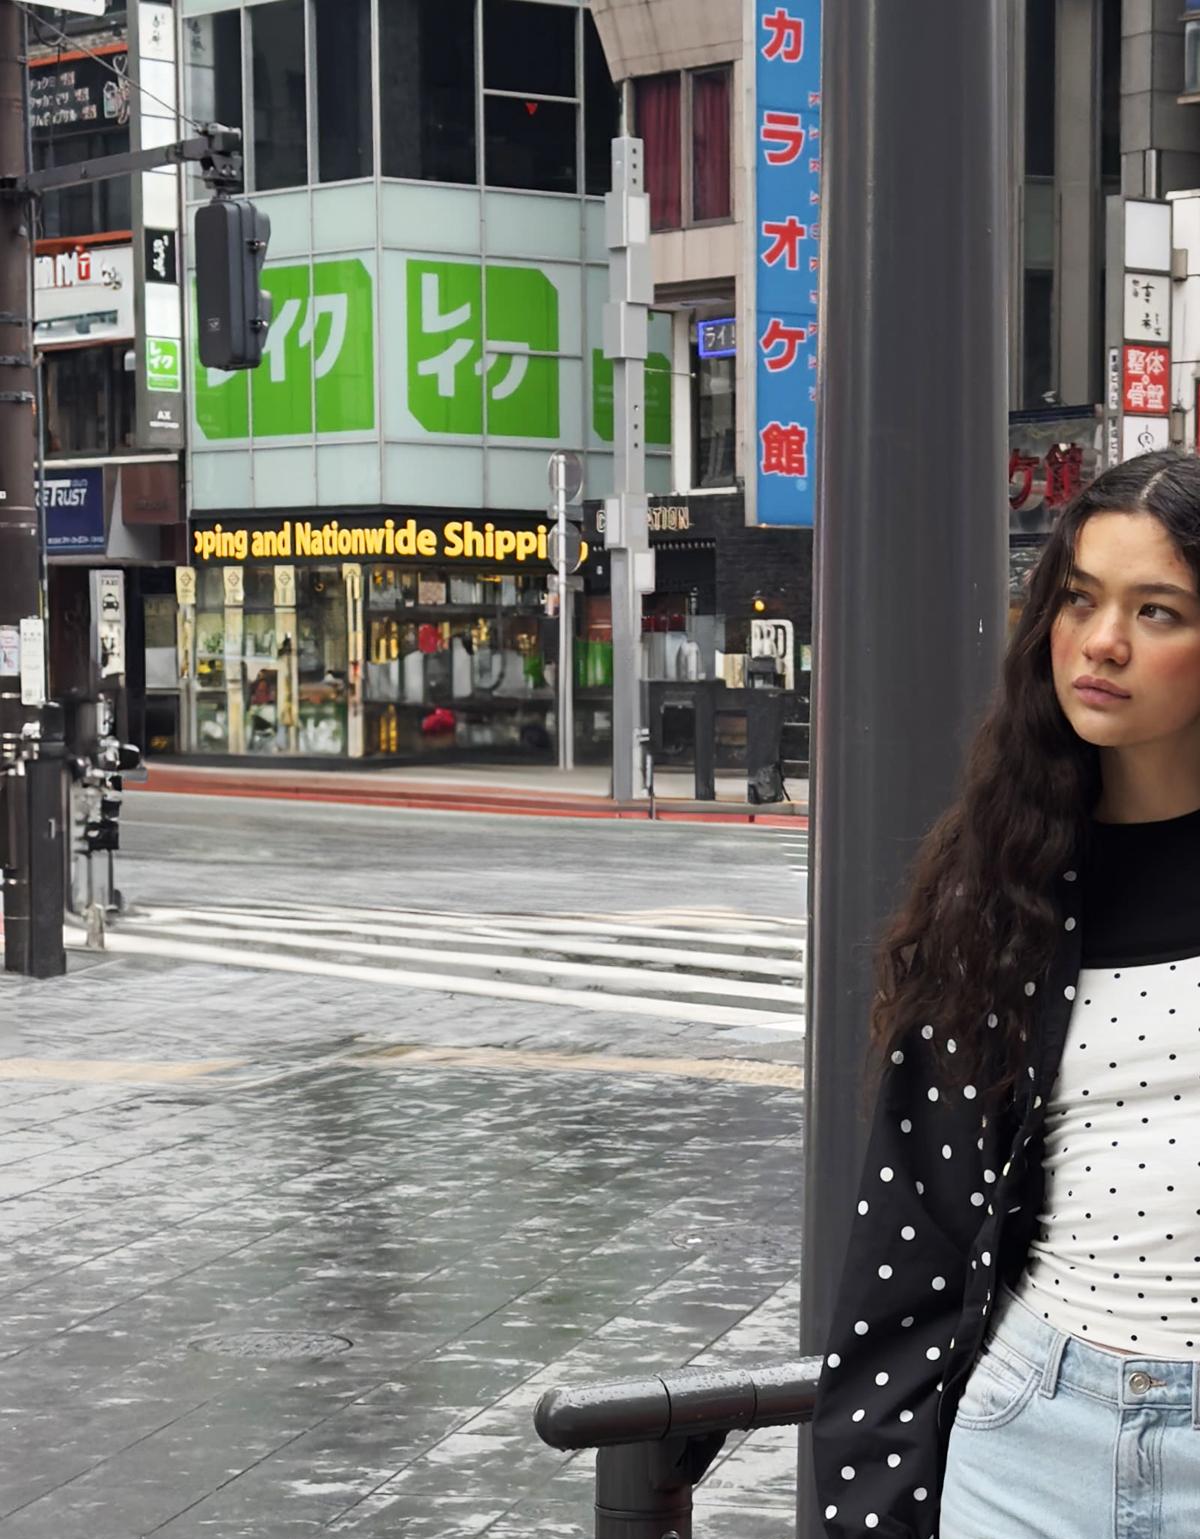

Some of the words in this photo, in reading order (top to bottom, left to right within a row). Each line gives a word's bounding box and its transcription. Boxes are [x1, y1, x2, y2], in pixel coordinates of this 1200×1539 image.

[760, 9, 808, 478] カラオケ館
[150, 341, 174, 369] レイク
[207, 293, 348, 388] イク
[417, 272, 530, 400] レイク
[1126, 349, 1165, 376] 整体
[251, 521, 291, 557] and
[294, 518, 438, 557] Nationwide
[443, 520, 589, 562] Shippi
